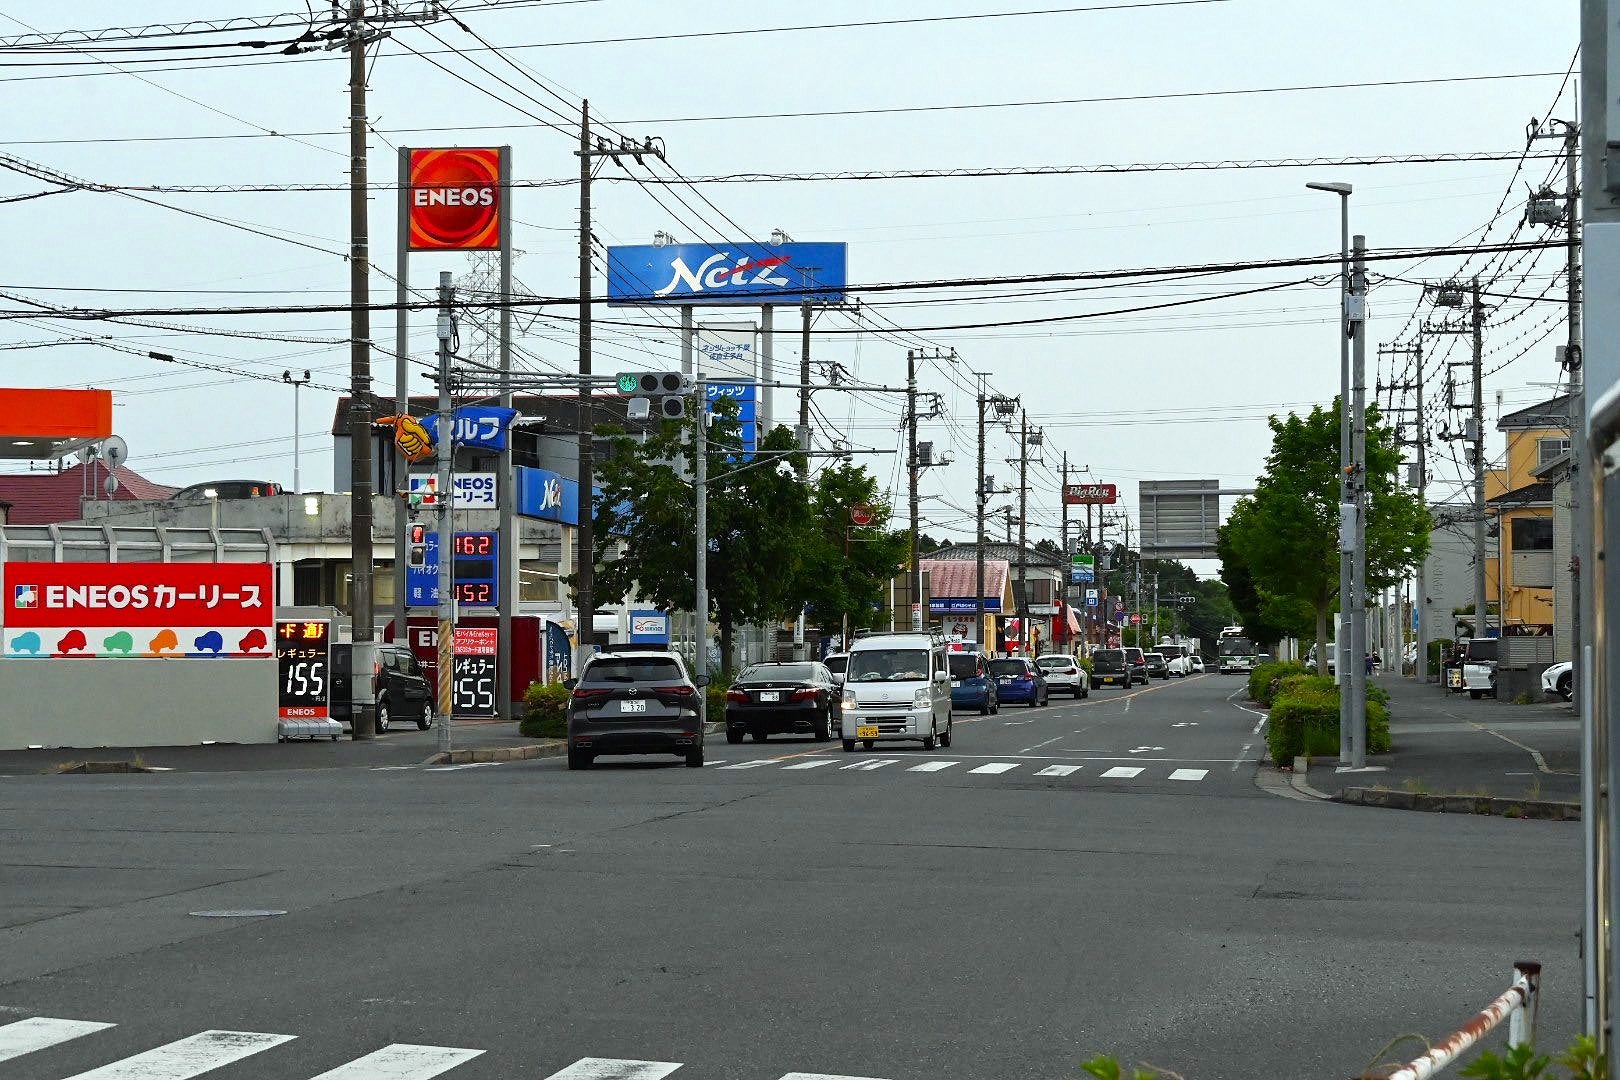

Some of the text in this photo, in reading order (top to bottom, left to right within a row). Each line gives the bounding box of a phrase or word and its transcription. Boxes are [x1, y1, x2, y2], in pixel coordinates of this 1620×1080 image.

[414, 188, 493, 206] ENEOS
[654, 252, 792, 298] Netz
[708, 386, 745, 397] ヴィッツ
[454, 478, 494, 489] NEOS
[454, 492, 494, 502] ーリース
[456, 536, 489, 555] 162
[46, 585, 262, 608] ENEOS カーリース
[456, 584, 489, 602] 152
[277, 648, 326, 658] レギュラー
[455, 658, 494, 675] レギュラー
[286, 662, 324, 696] 155
[453, 678, 493, 708] 155
[287, 708, 315, 716] ENEOS
